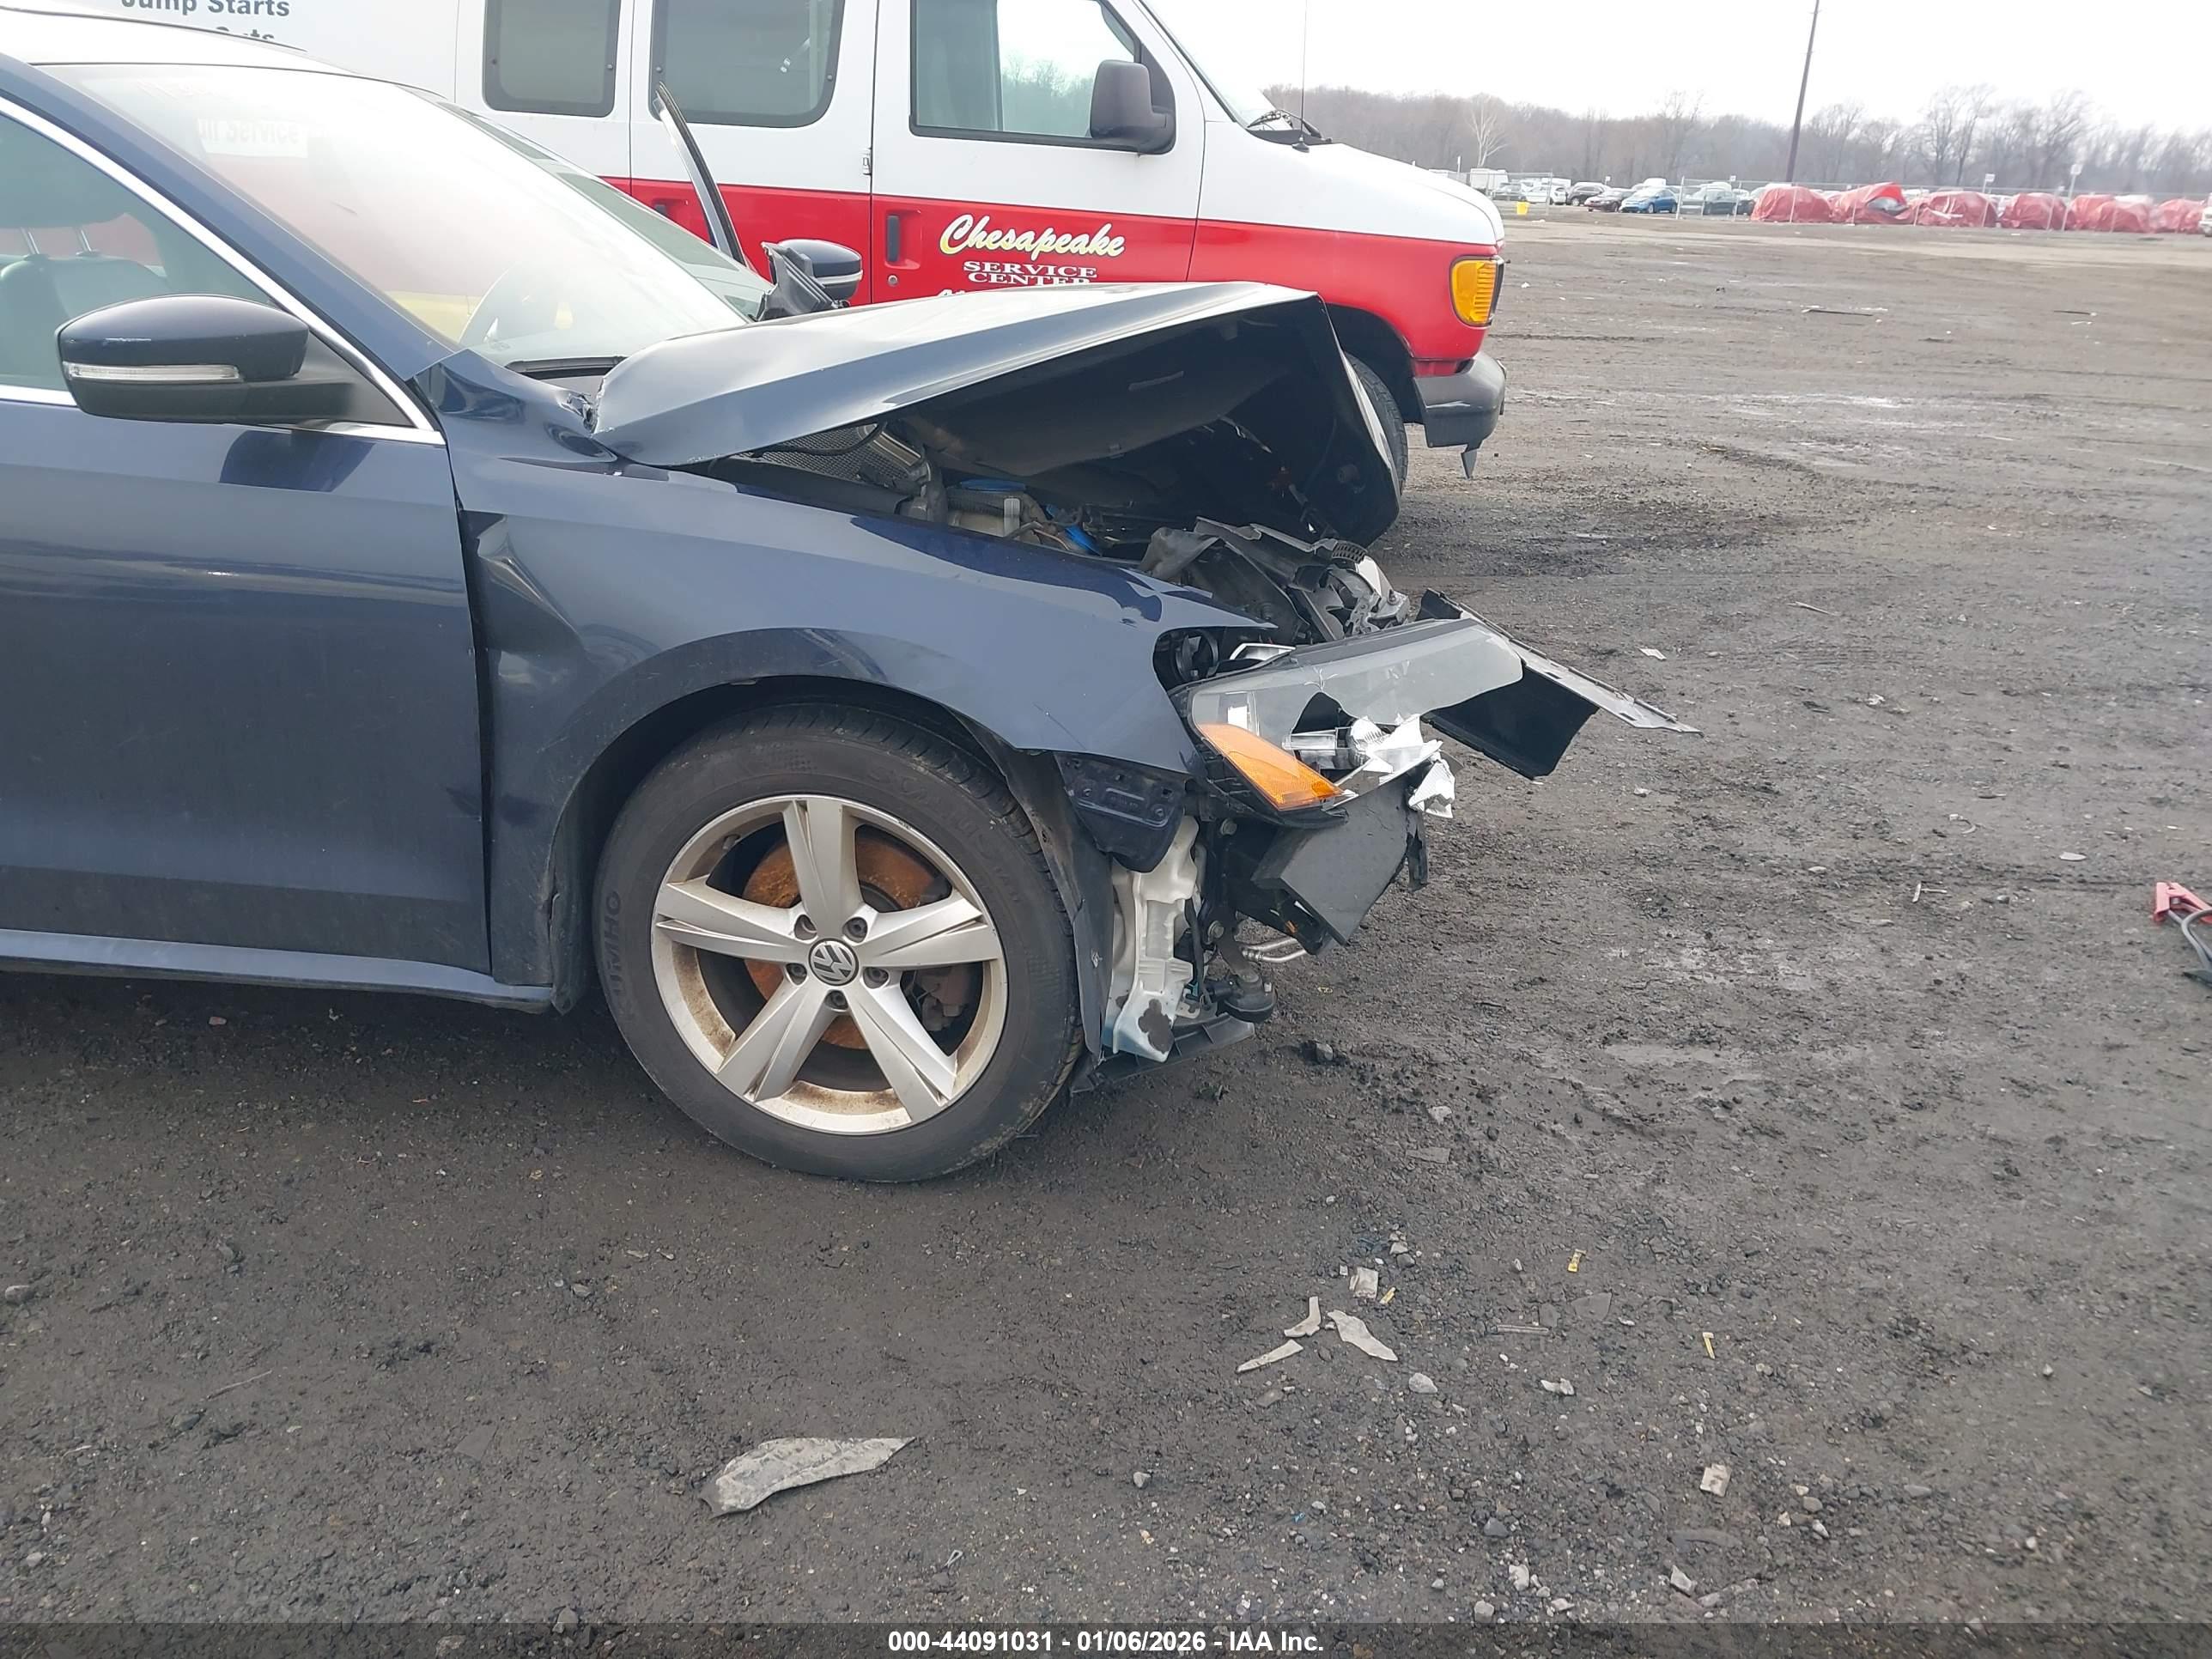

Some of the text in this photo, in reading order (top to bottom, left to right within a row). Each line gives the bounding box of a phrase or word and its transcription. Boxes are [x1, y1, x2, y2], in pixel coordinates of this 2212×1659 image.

[207, 0, 290, 17] Starts
[939, 214, 1127, 261] Chesapeake
[963, 260, 1098, 278] SERVICE
